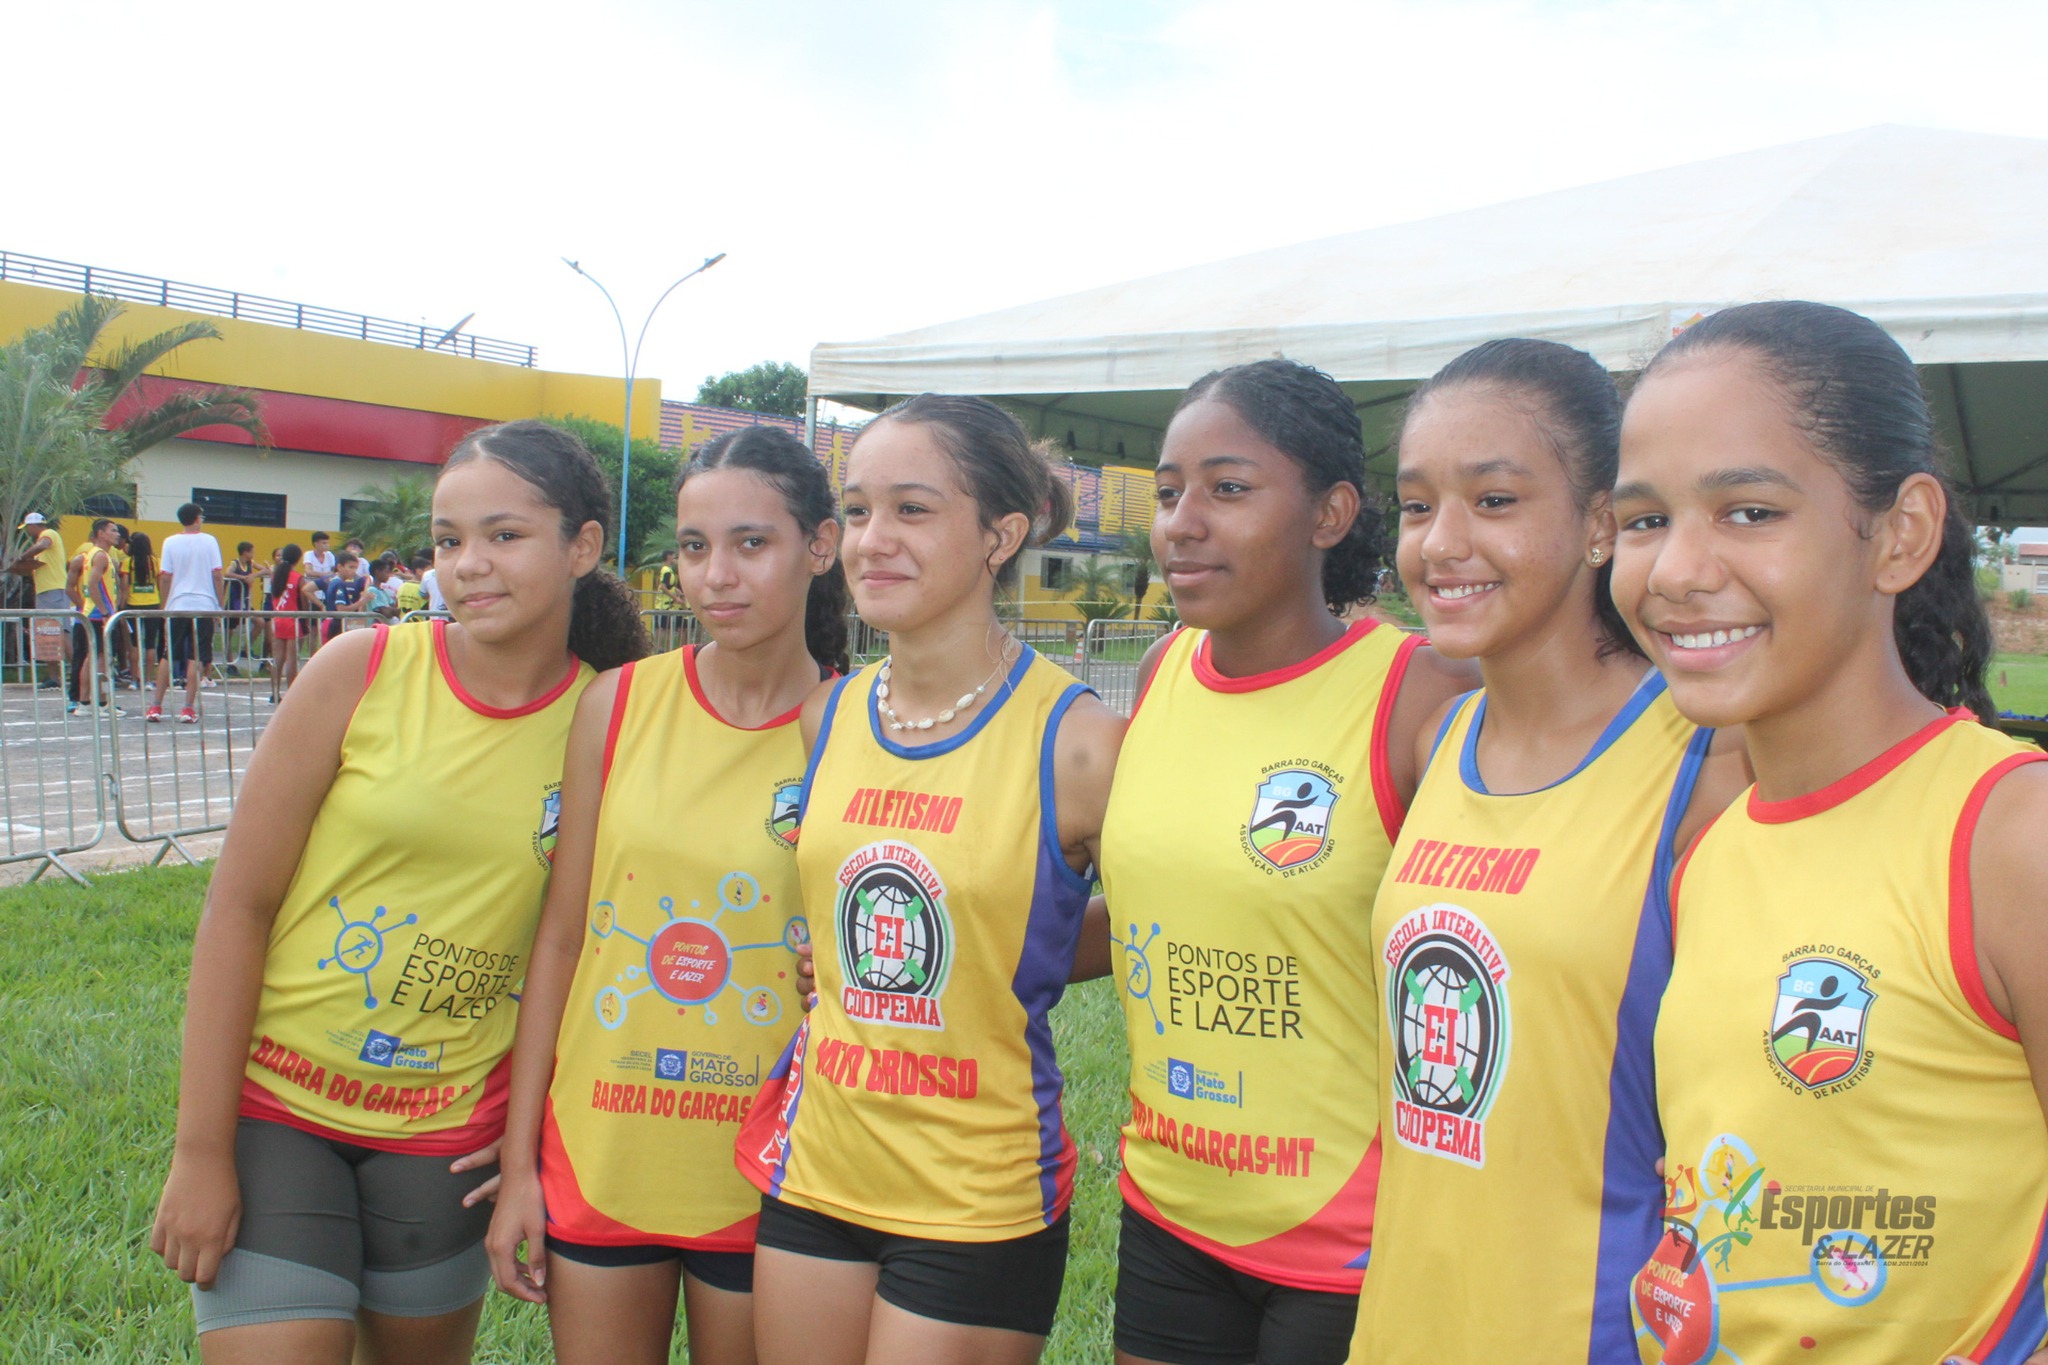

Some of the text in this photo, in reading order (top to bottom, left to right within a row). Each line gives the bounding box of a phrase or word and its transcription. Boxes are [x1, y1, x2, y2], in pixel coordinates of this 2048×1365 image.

[544, 781, 562, 791] BARR
[774, 777, 797, 788] BARRA
[1261, 758, 1345, 784] BARRA DO GARÇAS
[1272, 786, 1292, 797] BG
[842, 788, 964, 834] ATLETISMO
[1294, 821, 1324, 835] AAT
[1240, 824, 1335, 878] ASSOCIAÇÃO DE ATLETISMO
[1394, 838, 1541, 895] ATLETISMO
[839, 845, 943, 901] ESCOLA INTERATIVA
[413, 933, 519, 972] PONTOS DE
[672, 941, 709, 956] PONTOS
[873, 914, 905, 960] EI
[1386, 910, 1507, 985] ESCOLA INTERATIVA
[402, 953, 510, 995] ESPORTE
[661, 955, 717, 970] DE ESPORTE
[669, 969, 705, 984] E LAZER
[1167, 942, 1298, 976] PONTOS DE
[1782, 944, 1881, 979] BARRA DO GARÇAS
[390, 980, 497, 1020] E LAZER
[1168, 966, 1301, 1007] ESPORTE
[1793, 979, 1815, 994] BG
[843, 986, 941, 1027] COOPEMA
[1170, 996, 1304, 1040] E LAZER
[1422, 1003, 1459, 1067] EI
[1819, 1027, 1857, 1045] AAT
[251, 1034, 326, 1095] BARRA
[326, 1073, 363, 1107] DO
[395, 1055, 435, 1070] Grosso
[690, 1057, 739, 1074] MATO
[692, 1051, 723, 1060] GOVERNO
[1763, 1030, 1875, 1100] ASSOCIAÇÃO DE ATLETISMO
[689, 1070, 755, 1087] GROSSO
[866, 1049, 978, 1099] GROSSO
[1196, 1074, 1225, 1090] Mato
[592, 1079, 647, 1114] BARRA
[650, 1087, 676, 1119] DO
[1196, 1086, 1237, 1104] Grosso
[1157, 1112, 1179, 1154] DO
[1182, 1123, 1315, 1177] GARÇAS-MT
[1396, 1100, 1481, 1162] COOPEMA
[1647, 1258, 1688, 1288] PONTOS
[1641, 1279, 1695, 1317] DE ESPORTE
[1656, 1308, 1683, 1338] E LAZER
